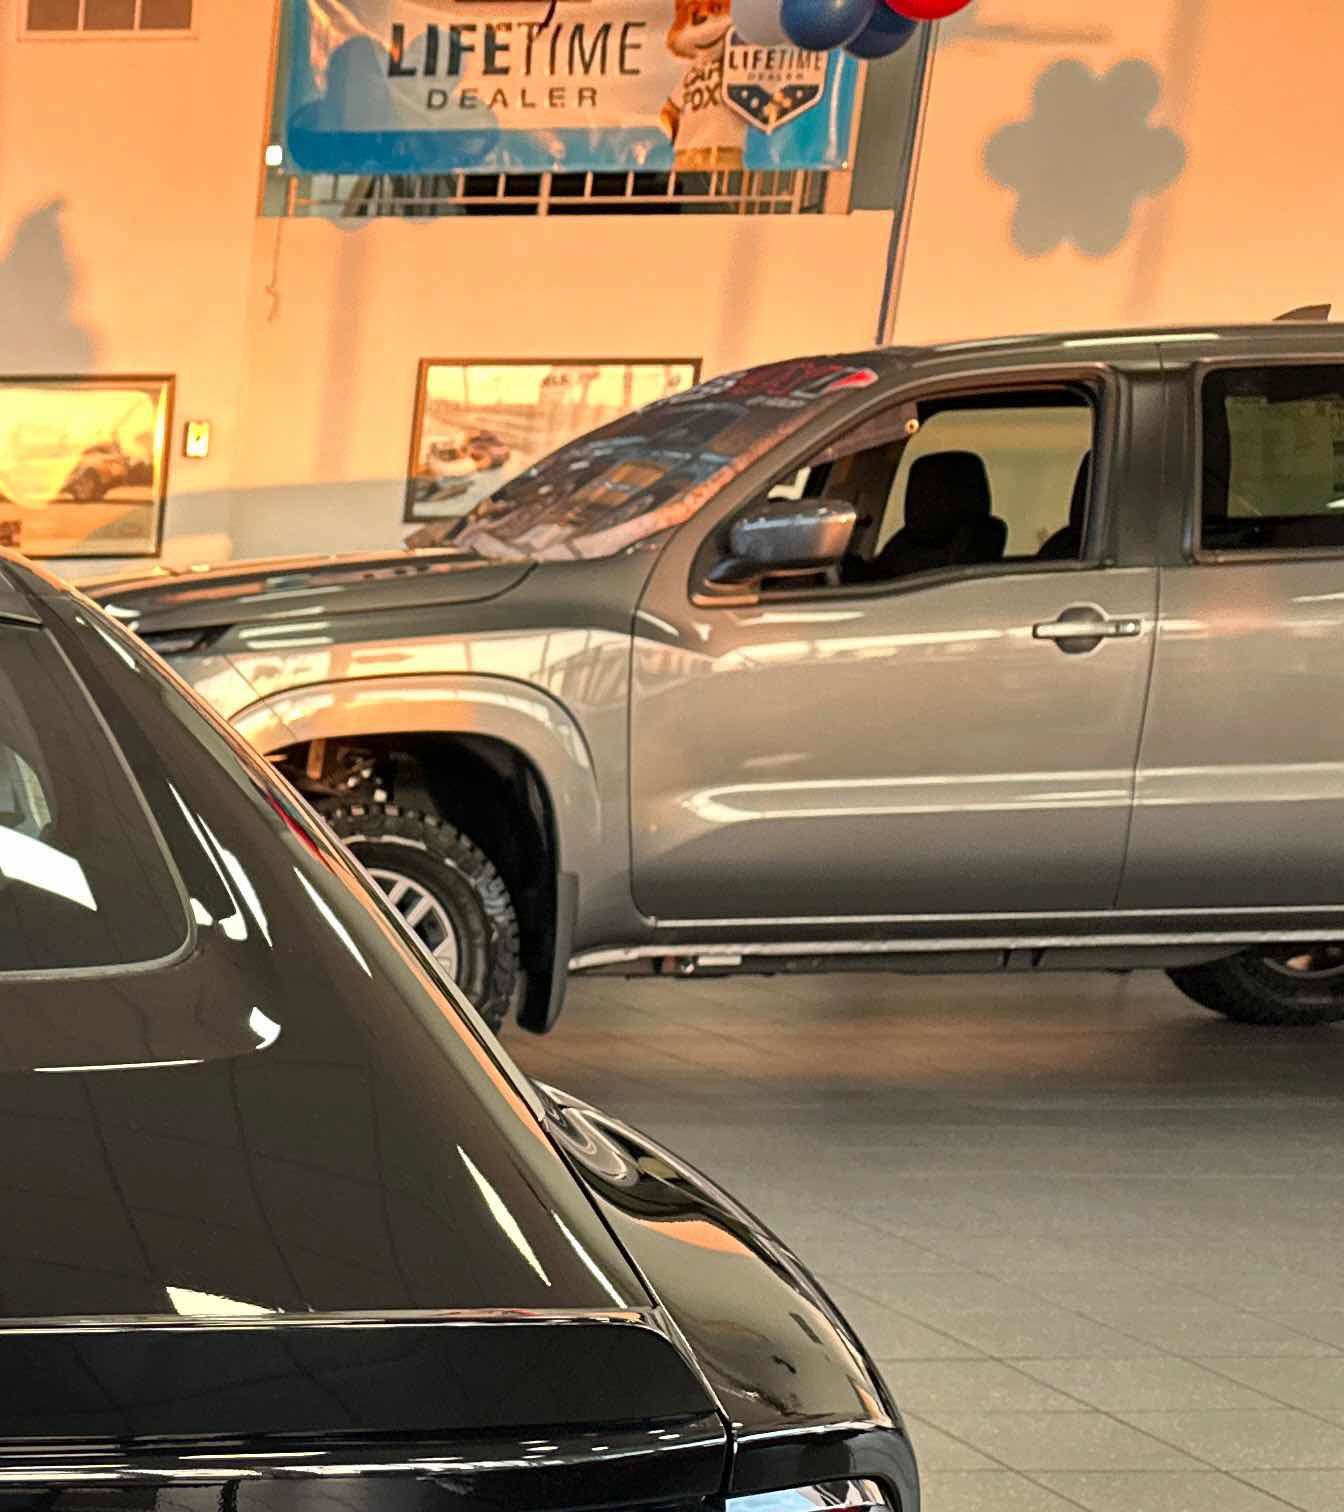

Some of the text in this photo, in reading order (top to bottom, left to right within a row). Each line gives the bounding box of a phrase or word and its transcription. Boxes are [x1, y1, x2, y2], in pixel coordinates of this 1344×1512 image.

[387, 21, 647, 77] LIFETIME
[728, 47, 822, 70] LIFETIME
[426, 87, 598, 110] DEALER
